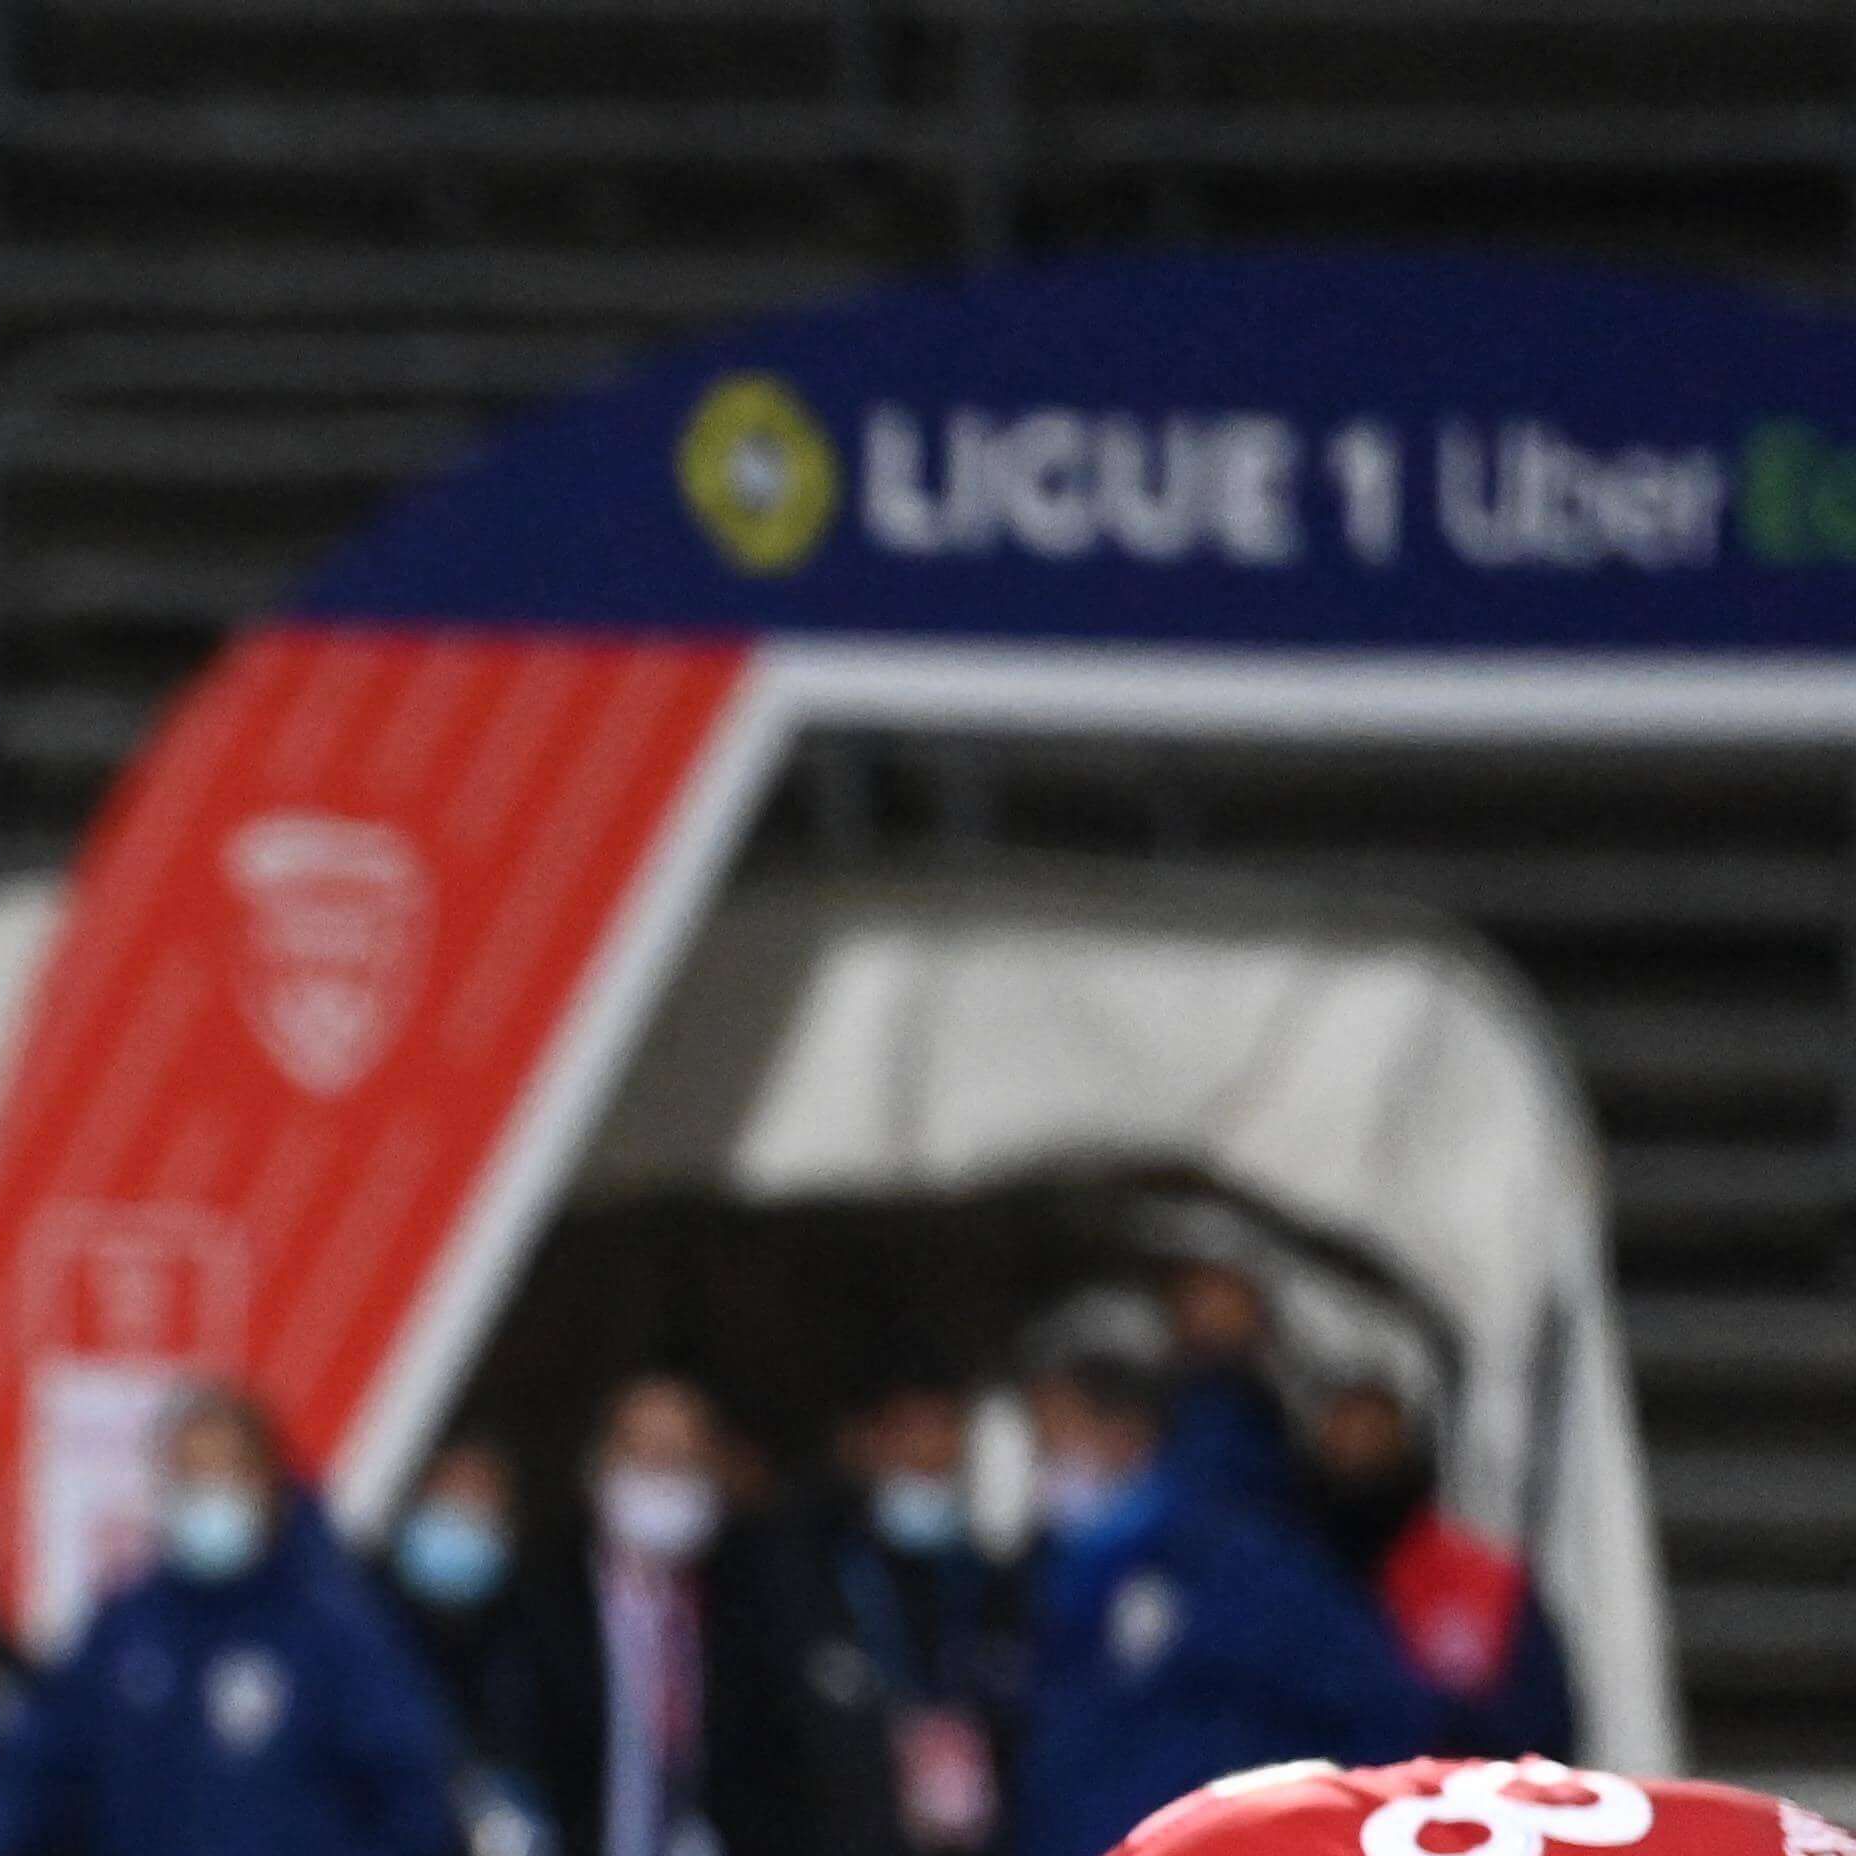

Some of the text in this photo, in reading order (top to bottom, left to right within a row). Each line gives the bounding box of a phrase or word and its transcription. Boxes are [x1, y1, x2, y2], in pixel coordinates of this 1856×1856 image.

[863, 408, 1296, 556] LIGUE
[1328, 420, 1400, 563] 1
[1435, 415, 1718, 568] Uber
